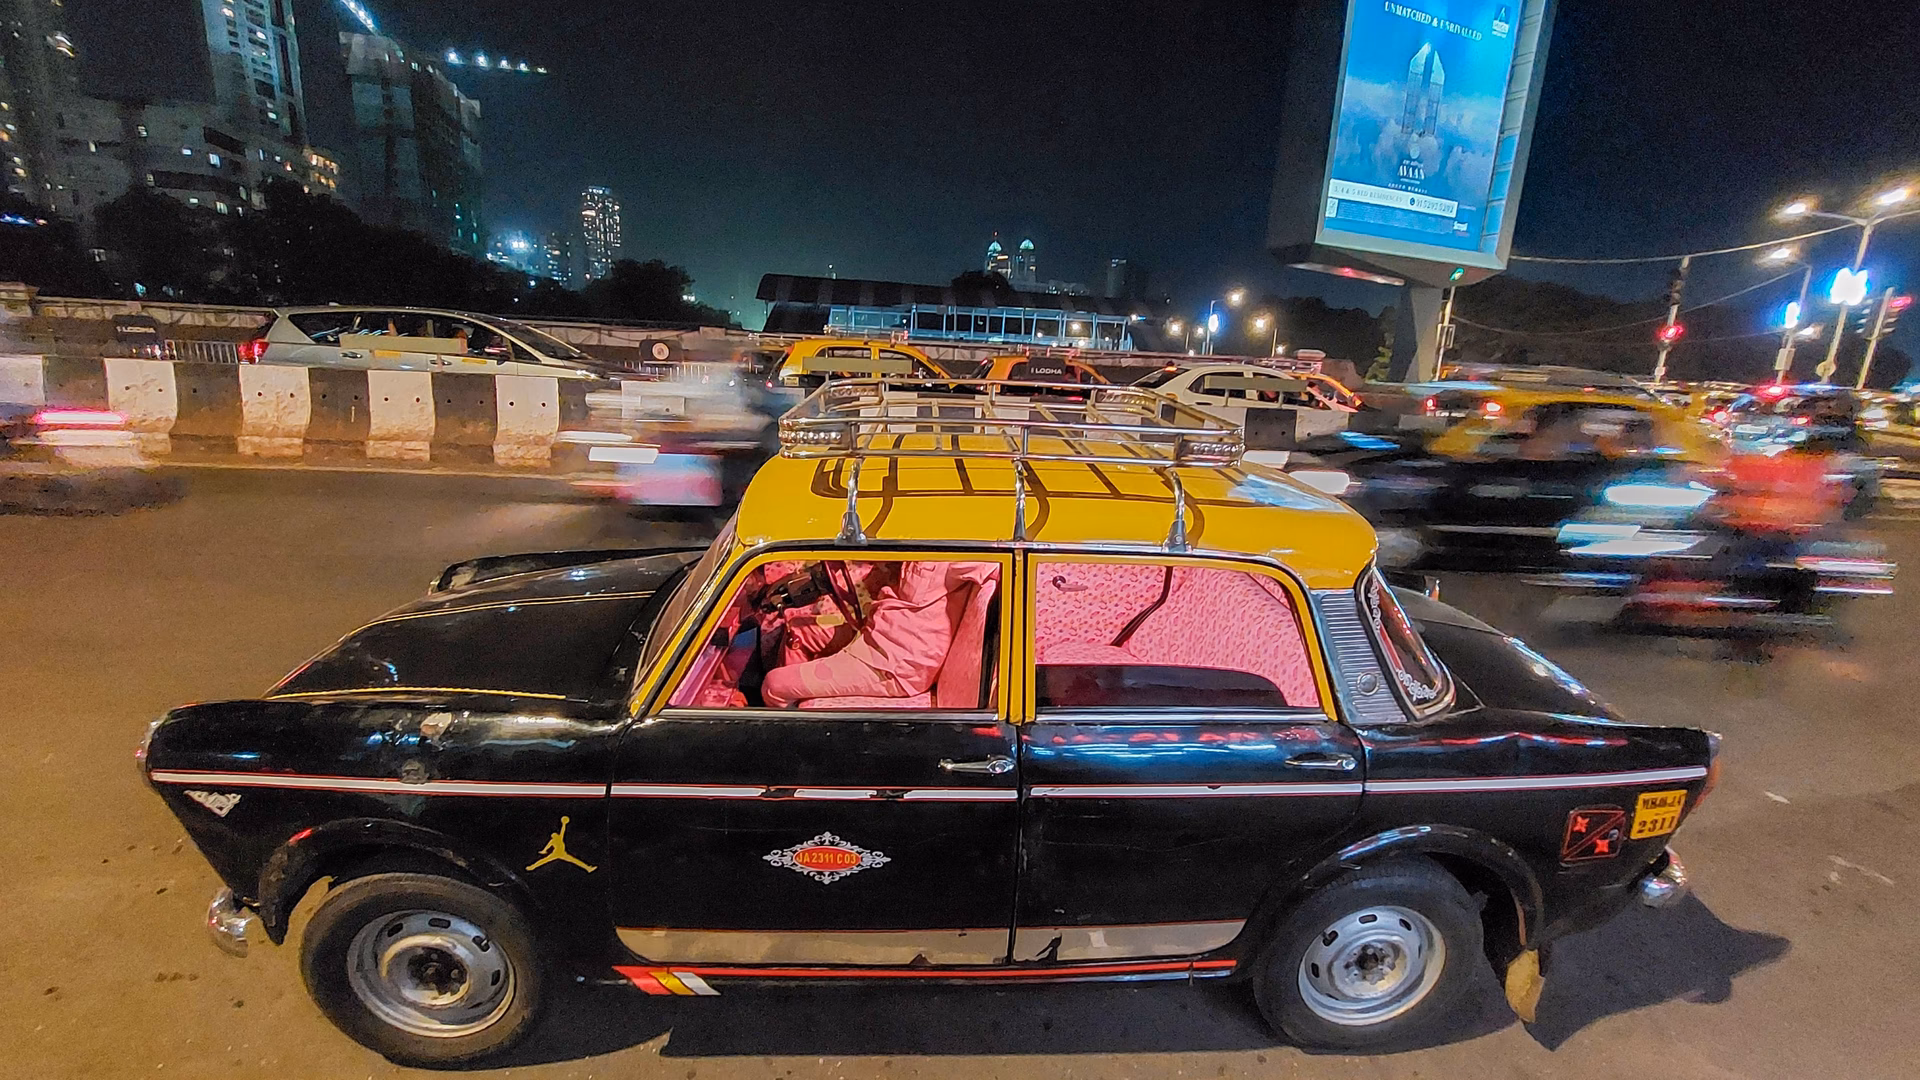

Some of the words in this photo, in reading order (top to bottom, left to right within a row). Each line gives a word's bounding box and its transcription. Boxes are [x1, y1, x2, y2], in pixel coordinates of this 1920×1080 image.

[1431, 16, 1439, 28] &
[1035, 367, 1063, 375] LODHA
[1636, 815, 1676, 834] 2311
